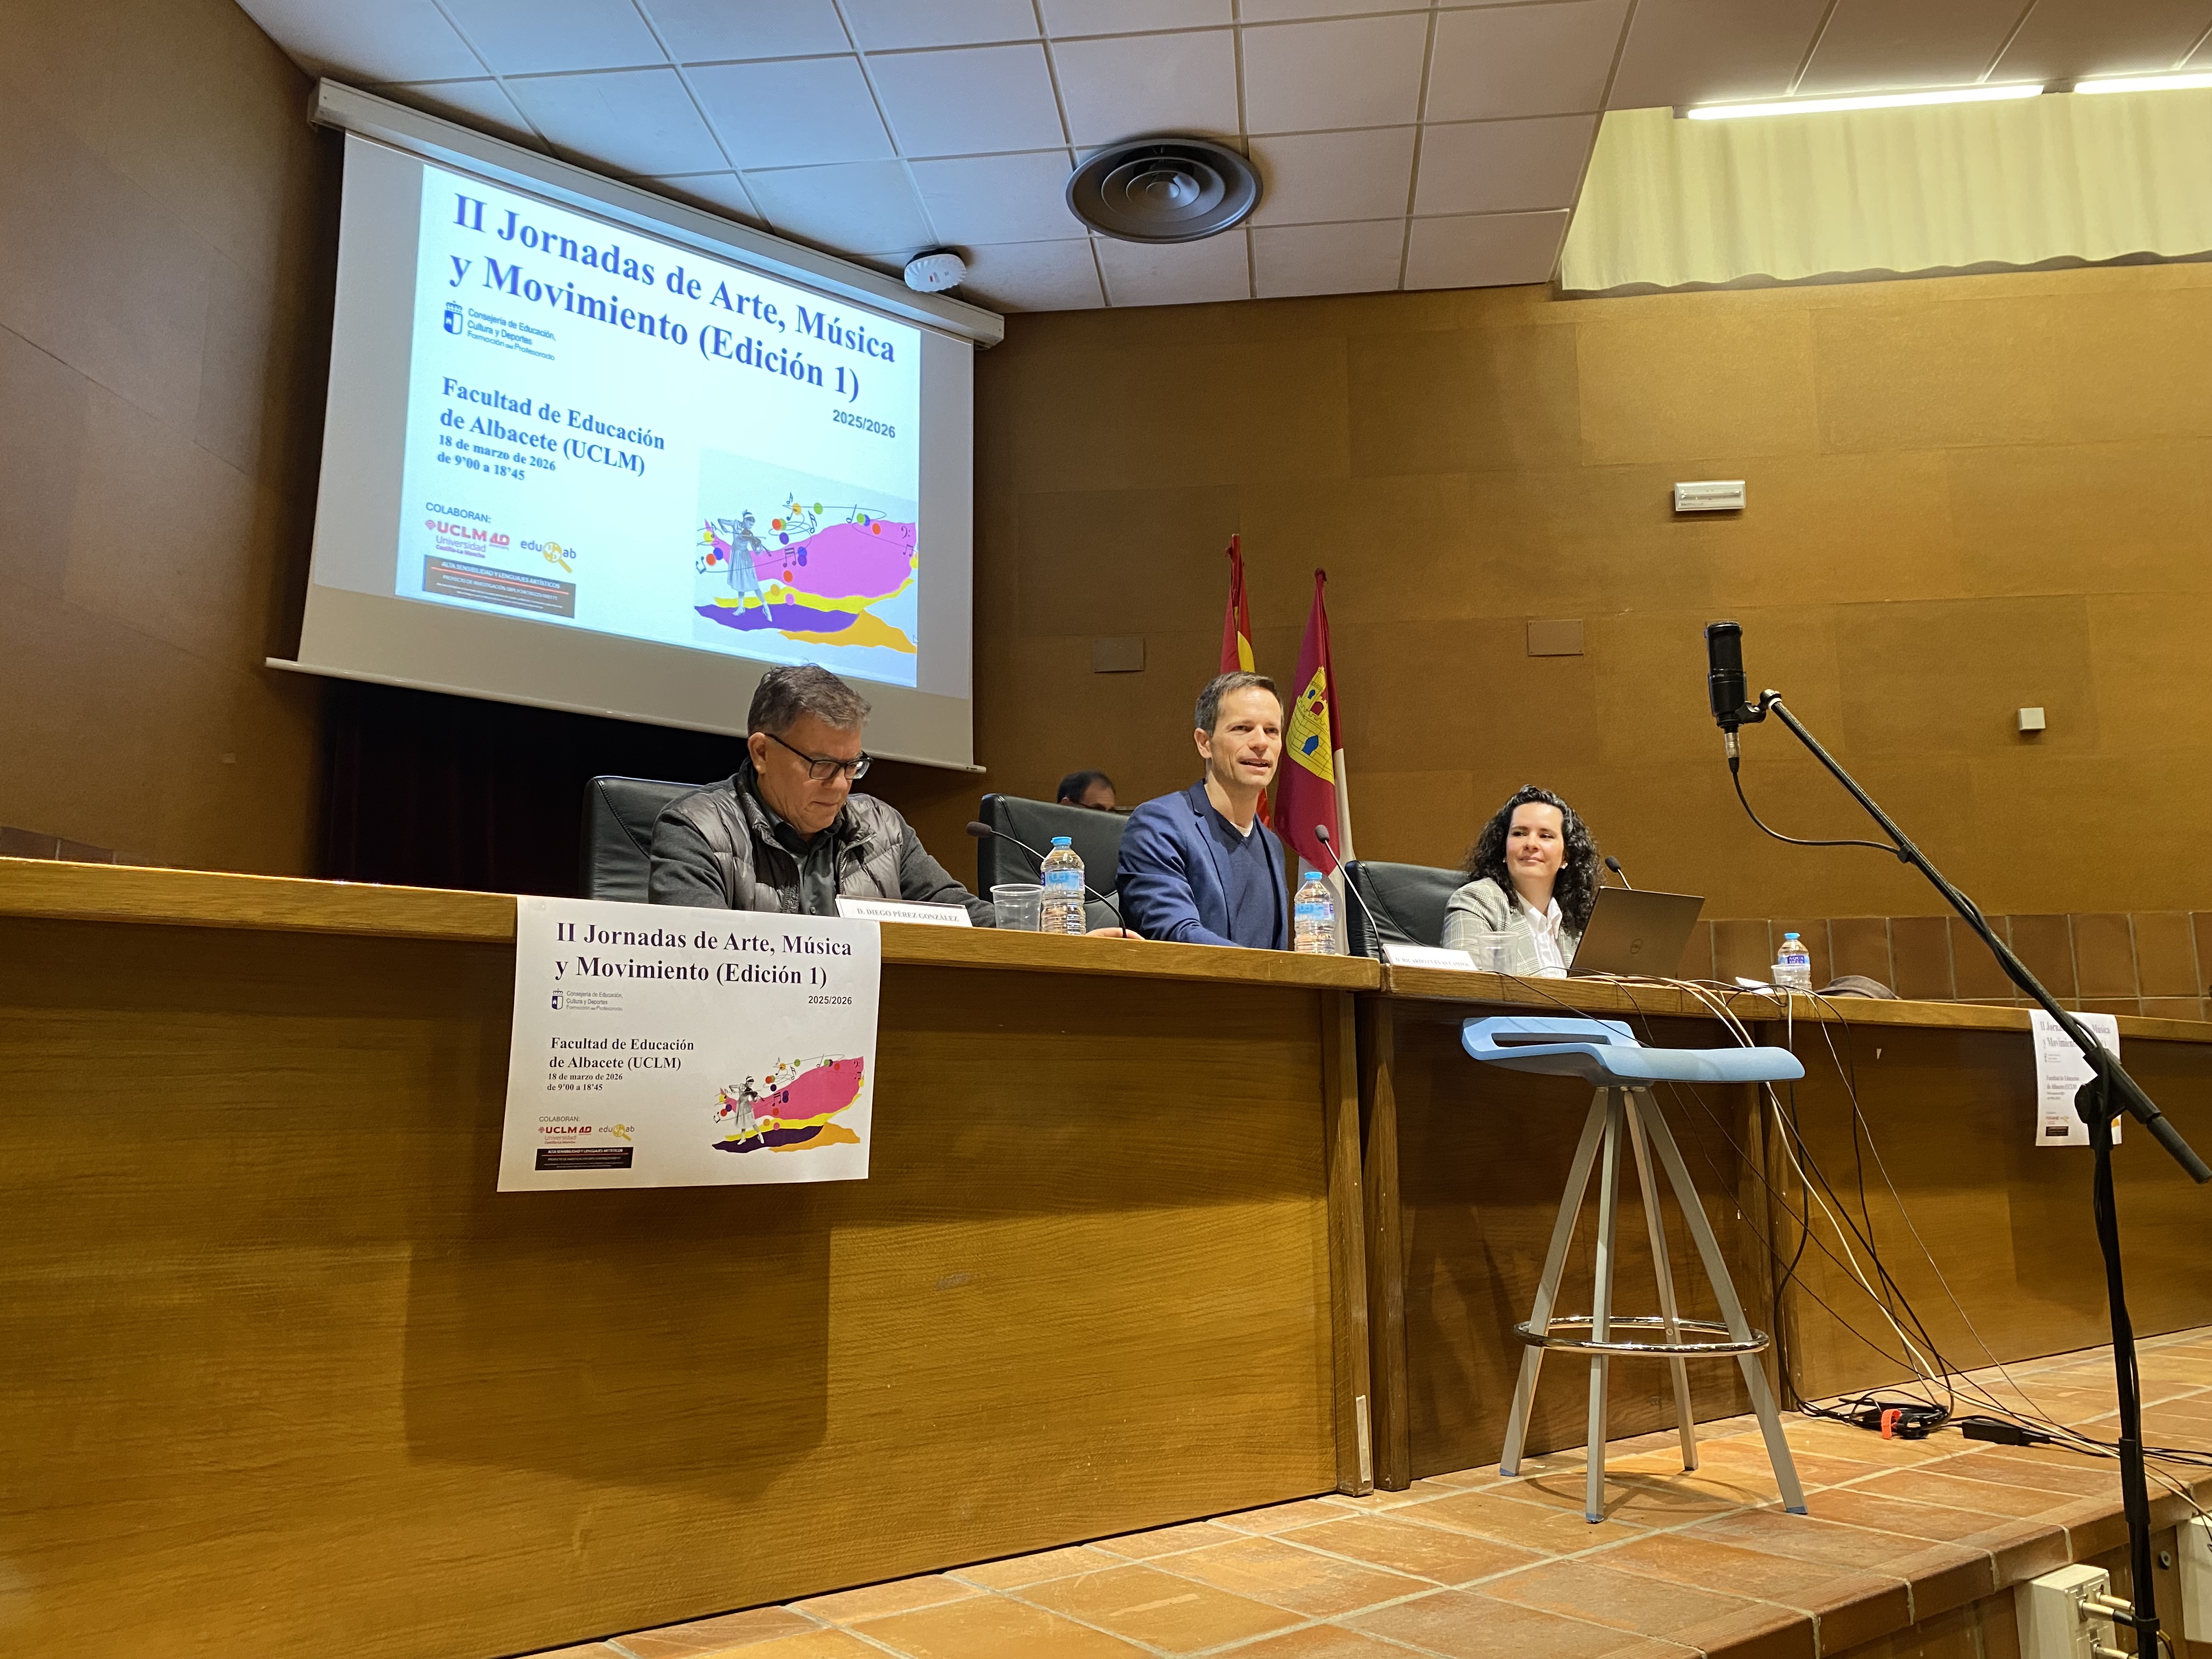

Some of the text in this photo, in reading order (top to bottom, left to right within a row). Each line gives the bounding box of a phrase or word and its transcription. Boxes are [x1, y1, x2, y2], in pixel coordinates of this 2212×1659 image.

[453, 193, 895, 362] II Jornadas de Arte, Música
[449, 255, 859, 403] y Movimiento (Edición 1)
[467, 320, 493, 335] Cultura
[501, 330, 532, 345] Deportes
[469, 308, 556, 341] Consejería de Educación,
[467, 330, 504, 347] Formación
[514, 343, 555, 360] Profesorado
[442, 376, 664, 450] Facultad de Educación
[833, 409, 895, 438] 2025/2026
[439, 435, 556, 471] 18 de marzo de 2026
[441, 409, 645, 477] de Albacete (UCLM)
[437, 452, 452, 464] de
[483, 462, 490, 472] a
[426, 502, 492, 523] COLABORAN:
[436, 535, 486, 552] Universidad
[437, 521, 487, 541] UCLM
[441, 561, 456, 569] ALTA
[456, 563, 494, 576] SENSIBILIDAD
[498, 572, 529, 583] LENGUAJES
[530, 577, 560, 589] ARTÍSTICOS
[893, 910, 918, 918] PÉREZ
[918, 913, 960, 922] GONZÁLEZ
[556, 922, 851, 956] II Jornadas de Arte, Música
[555, 956, 827, 989] y Movimiento (Edición 1)
[808, 996, 852, 1005] 2025/2026
[550, 1037, 694, 1051] Facultad de Educación
[549, 1057, 681, 1071] de Albacete (UCLM)
